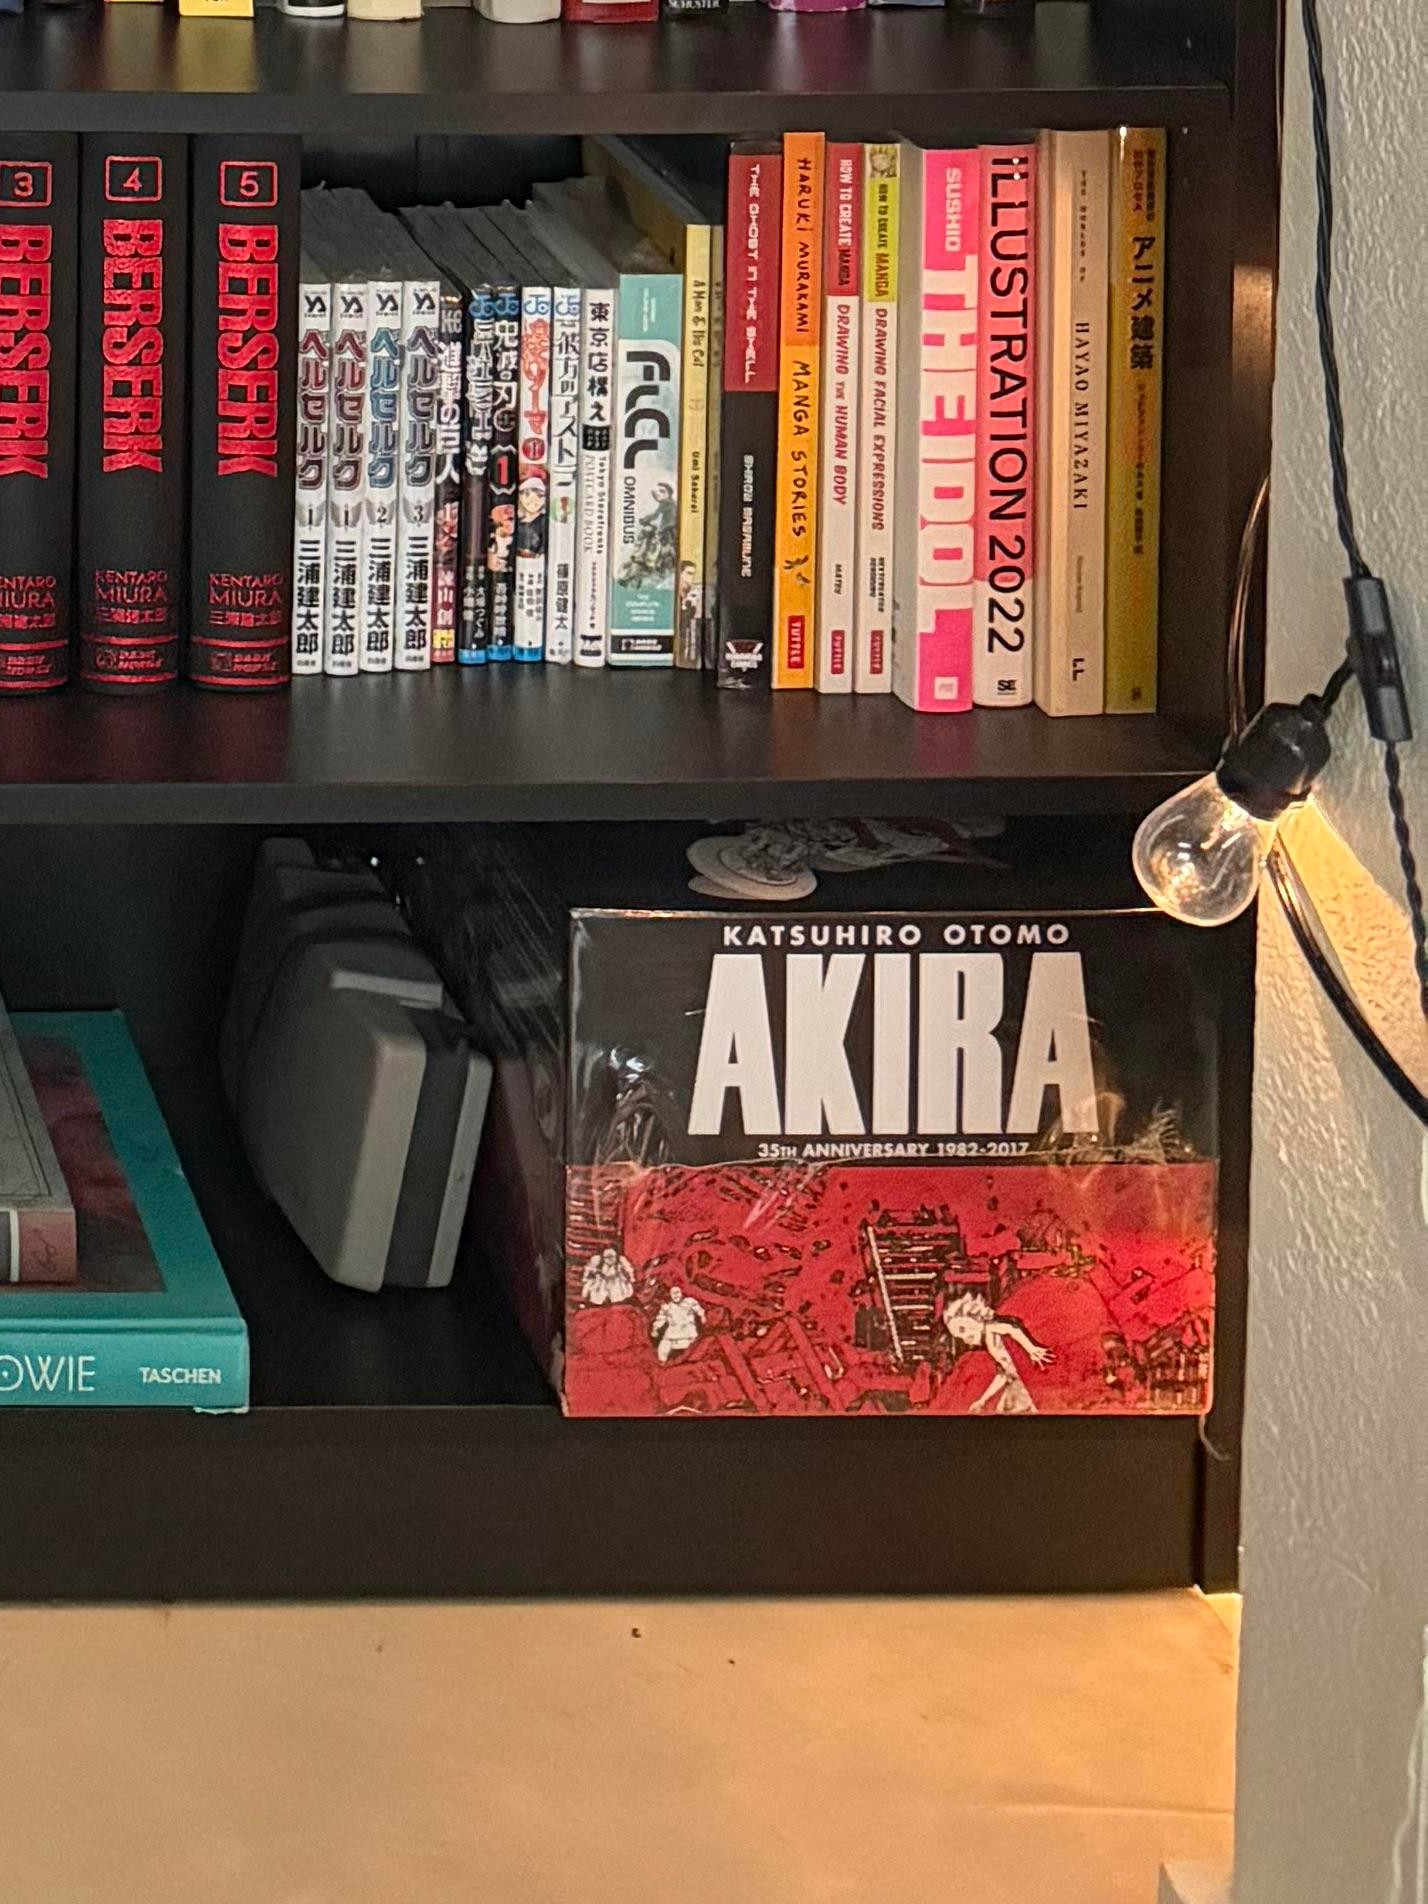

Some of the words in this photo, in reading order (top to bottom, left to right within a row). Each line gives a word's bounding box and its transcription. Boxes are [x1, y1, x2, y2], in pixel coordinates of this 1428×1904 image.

[11, 172, 34, 199] 3
[101, 217, 163, 474] BERSERK
[217, 223, 279, 477] BERSERK
[989, 155, 1030, 522] ILLUSTRATION
[622, 476, 636, 545] OMNIBUS
[988, 534, 1027, 656] 2022
[723, 924, 923, 947] KATSUHIRO
[943, 924, 1070, 947] OTOMO
[687, 951, 1100, 1136] AKIRA
[802, 1141, 931, 1159] ANNIVERSARY
[139, 1366, 222, 1385] TASCHEN
